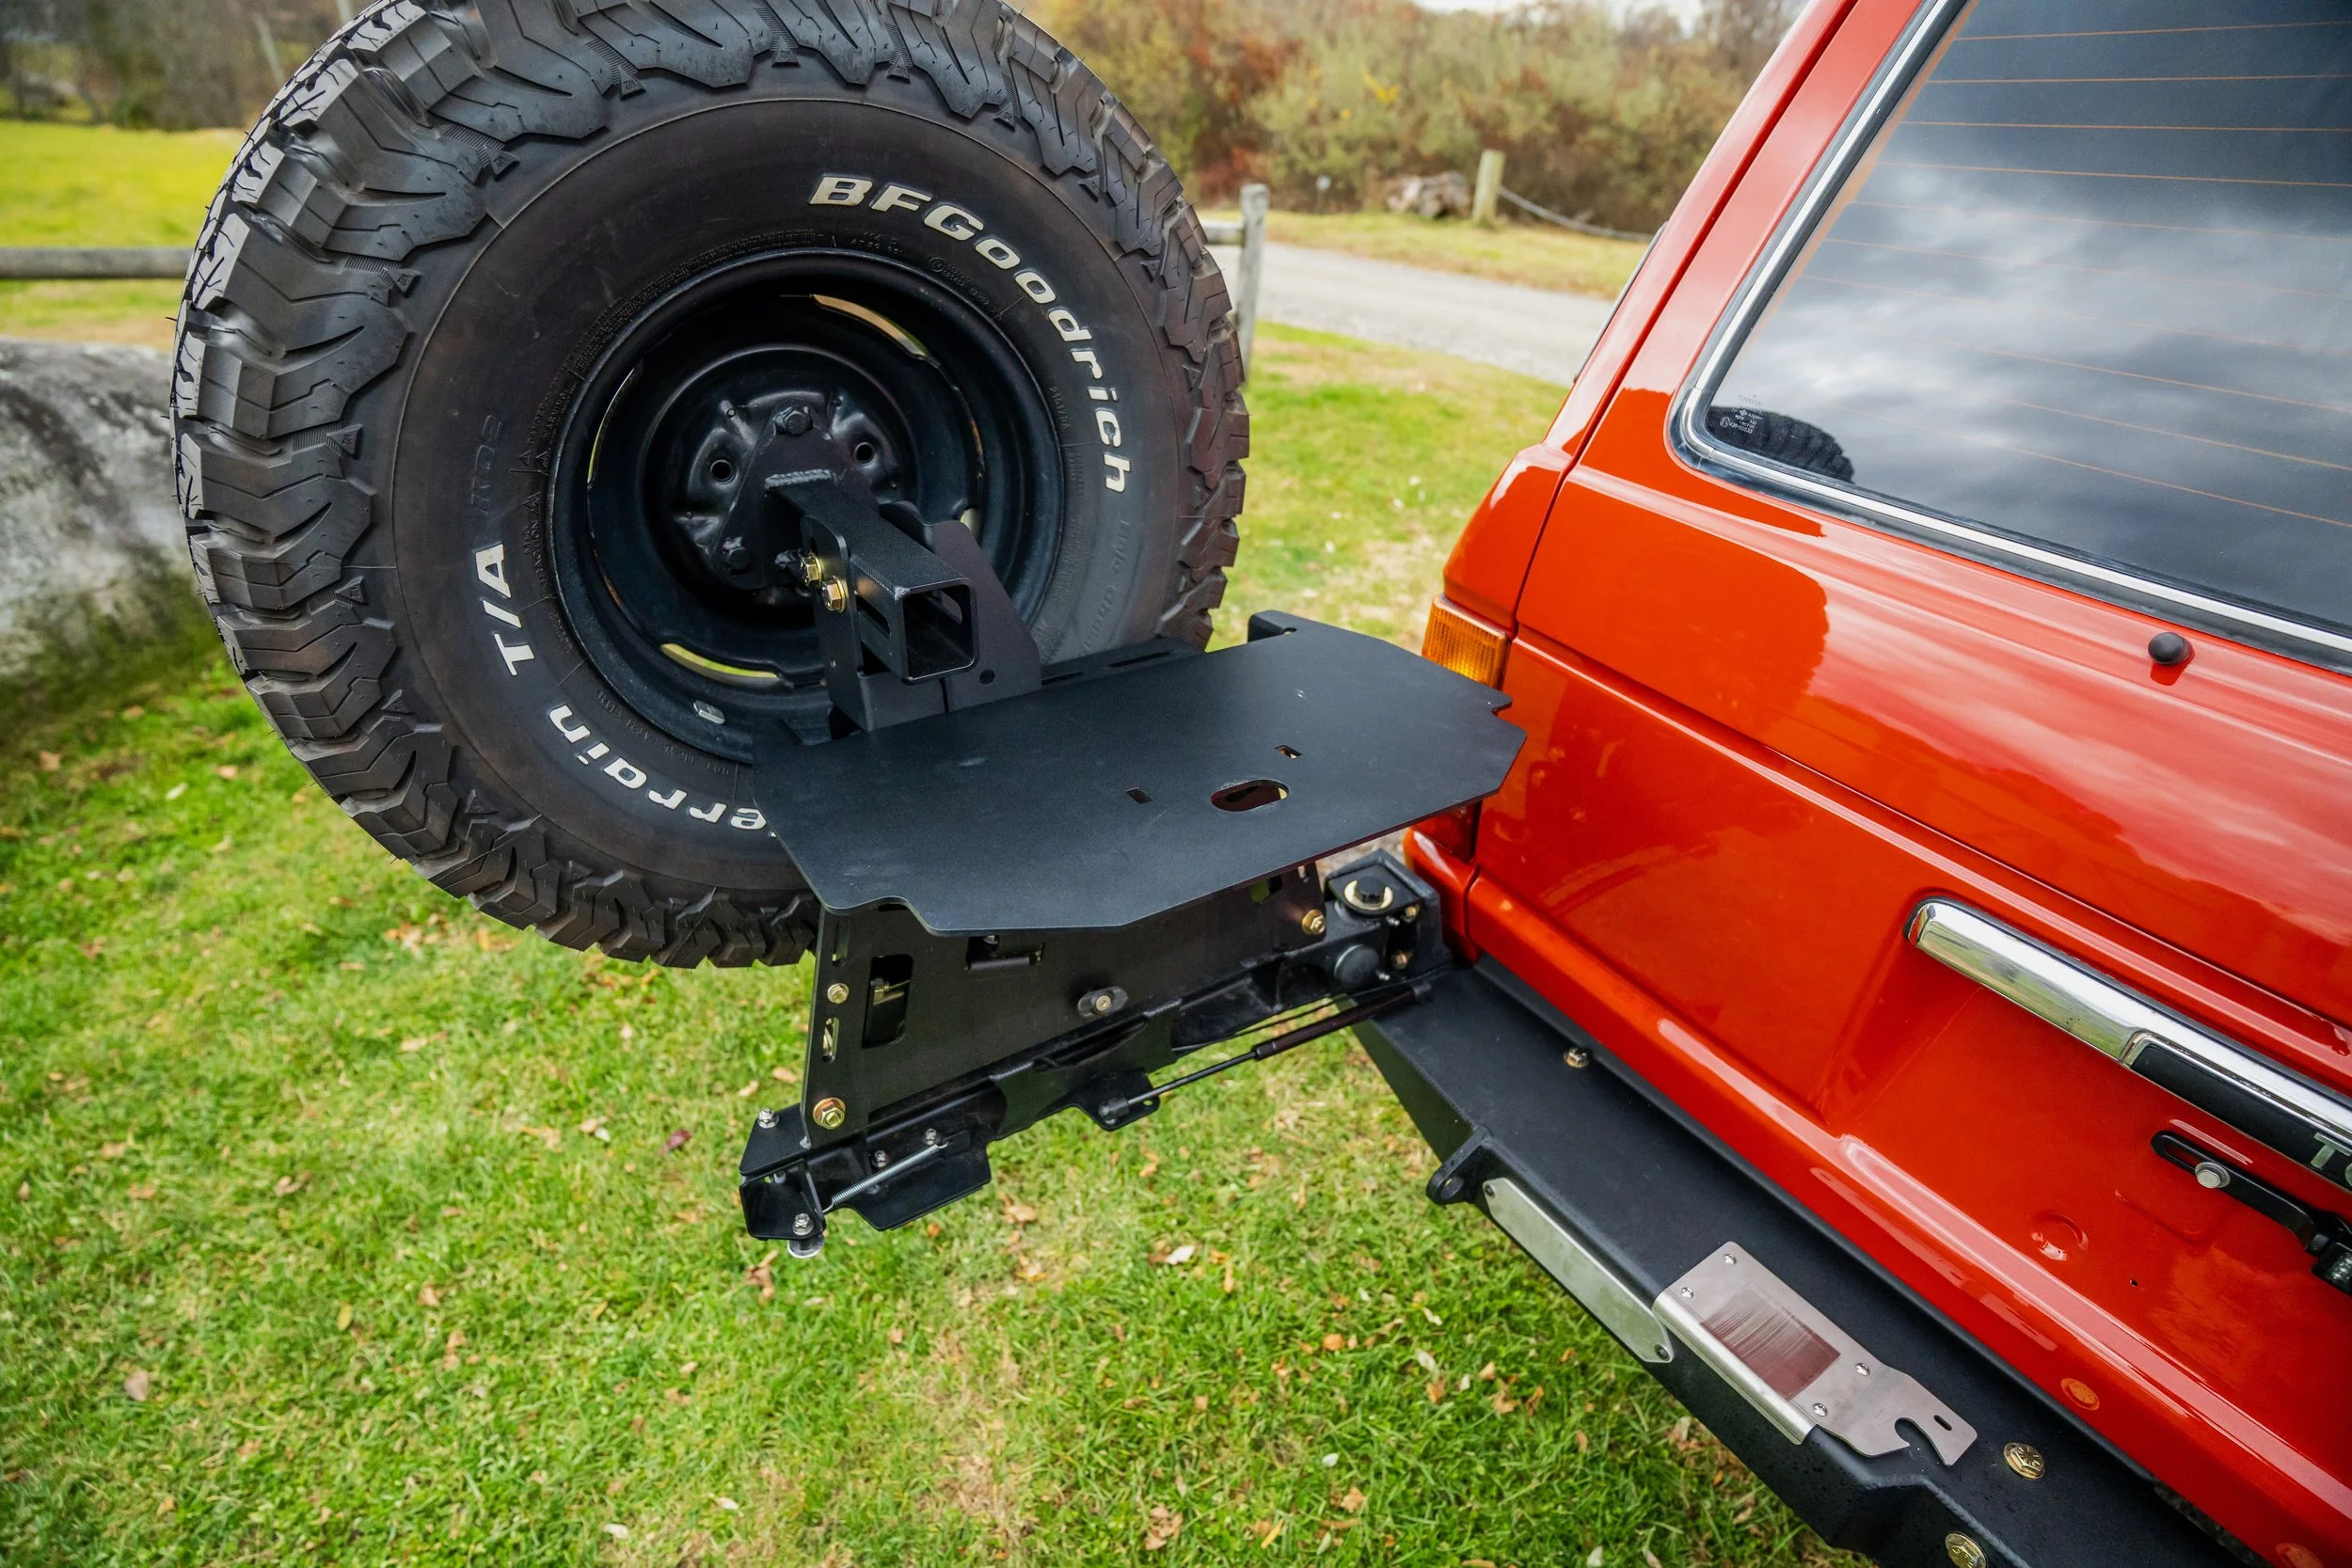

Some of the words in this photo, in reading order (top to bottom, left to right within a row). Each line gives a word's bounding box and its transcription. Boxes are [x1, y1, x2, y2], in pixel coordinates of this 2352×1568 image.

[807, 176, 1131, 493] BFGoodrich
[474, 544, 535, 676] T/A
[549, 705, 777, 837] errain
[2311, 1132, 2352, 1187] T
